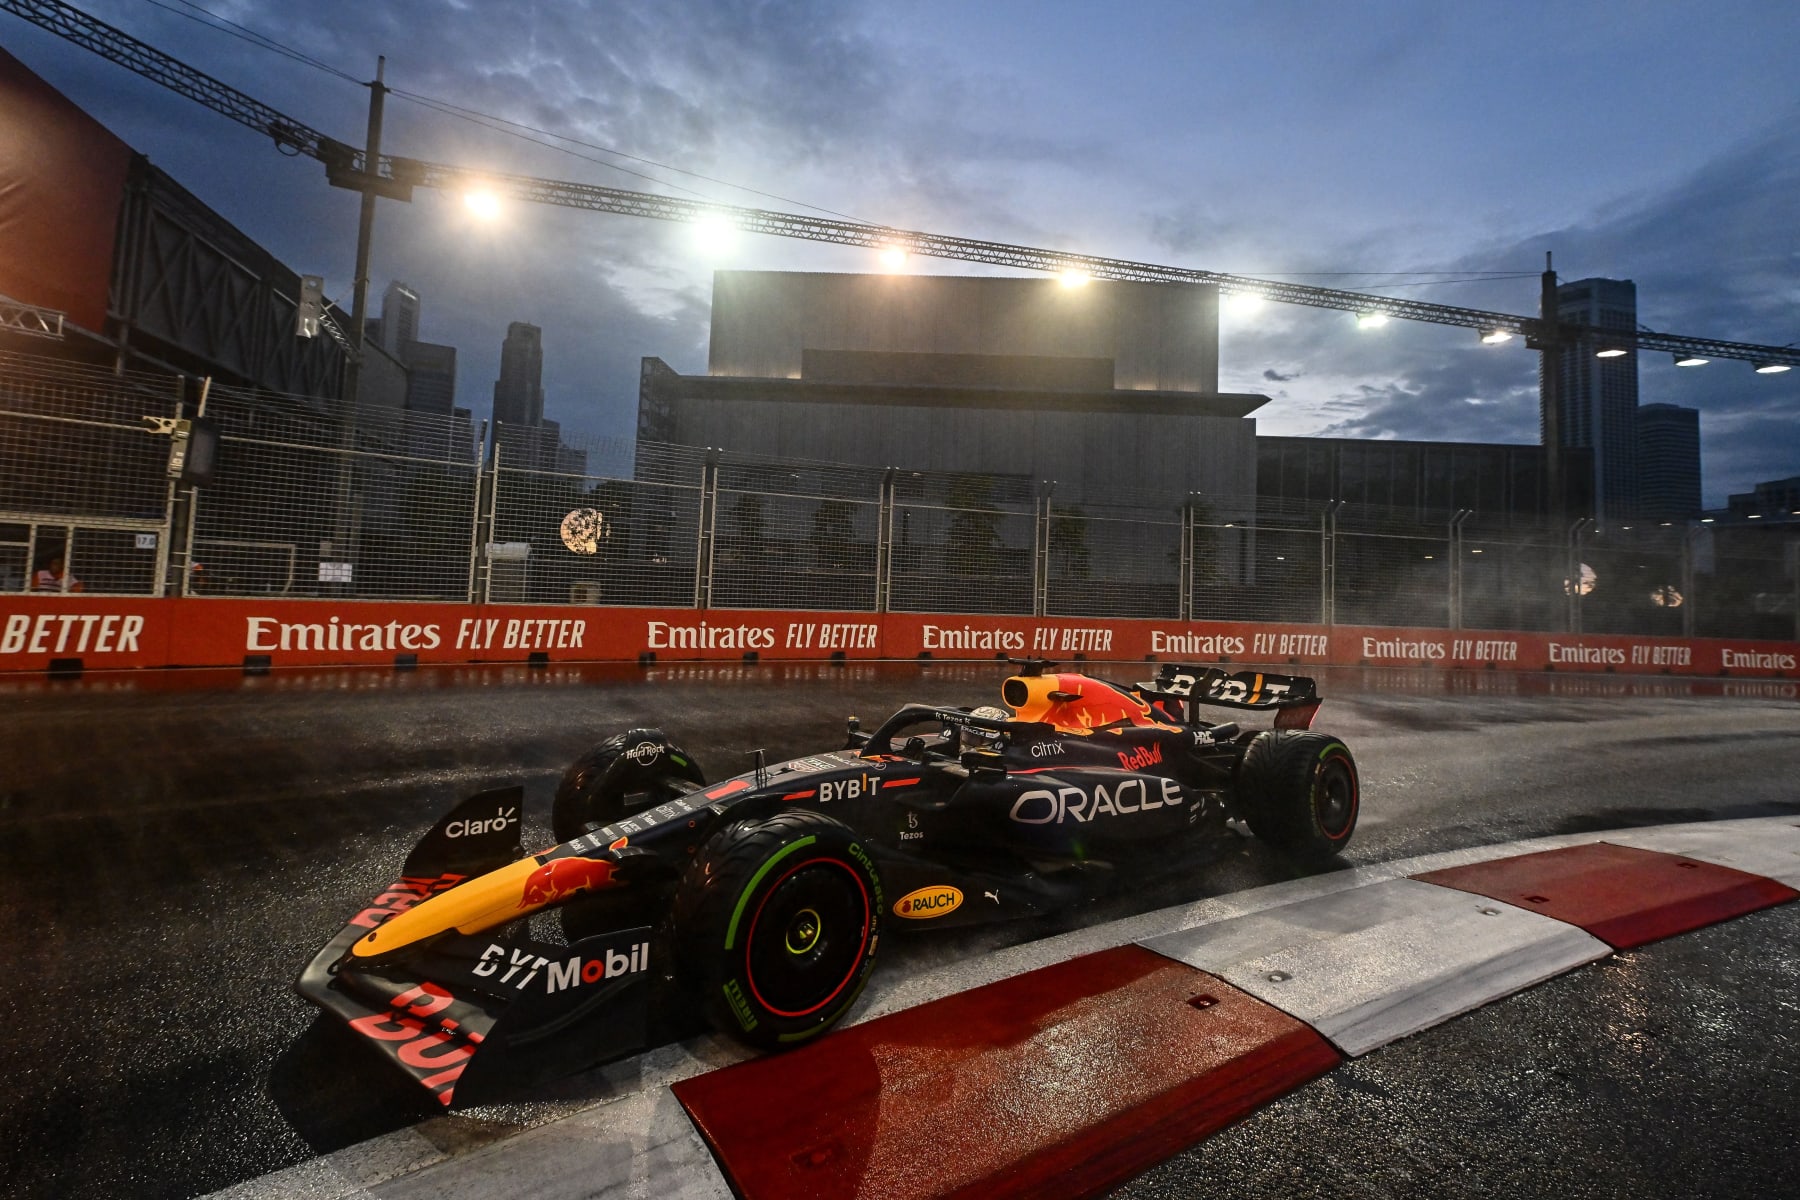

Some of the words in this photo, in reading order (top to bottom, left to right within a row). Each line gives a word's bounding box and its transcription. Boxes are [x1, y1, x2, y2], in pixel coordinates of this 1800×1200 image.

[1, 614, 145, 653] BETTER
[246, 616, 441, 651] Emirates
[456, 618, 499, 649] FLY
[503, 618, 587, 649] BETTER
[647, 621, 776, 649] Emirates
[786, 623, 818, 649] FLY
[819, 624, 878, 649] BETTER
[922, 625, 1025, 650] Emirates
[1033, 627, 1060, 651] FLY
[1060, 628, 1114, 652] BETTER
[1151, 630, 1246, 655] Emirates
[1253, 633, 1277, 655] FLY
[1279, 634, 1328, 656] BETTER
[1362, 636, 1447, 659] Emirates
[1452, 639, 1474, 660] FLY
[1475, 640, 1518, 661] BETTER
[1548, 642, 1627, 664] Emirates
[1631, 645, 1652, 665] FLY
[1652, 645, 1692, 666] BETTER
[1721, 648, 1797, 670] Emirates
[820, 773, 881, 803] BYBIT
[1009, 777, 1184, 825] ORACLE
[445, 816, 508, 838] Claro
[899, 831, 924, 840] Tezos
[912, 892, 955, 911] RAUCH
[546, 942, 650, 994] Mobil
